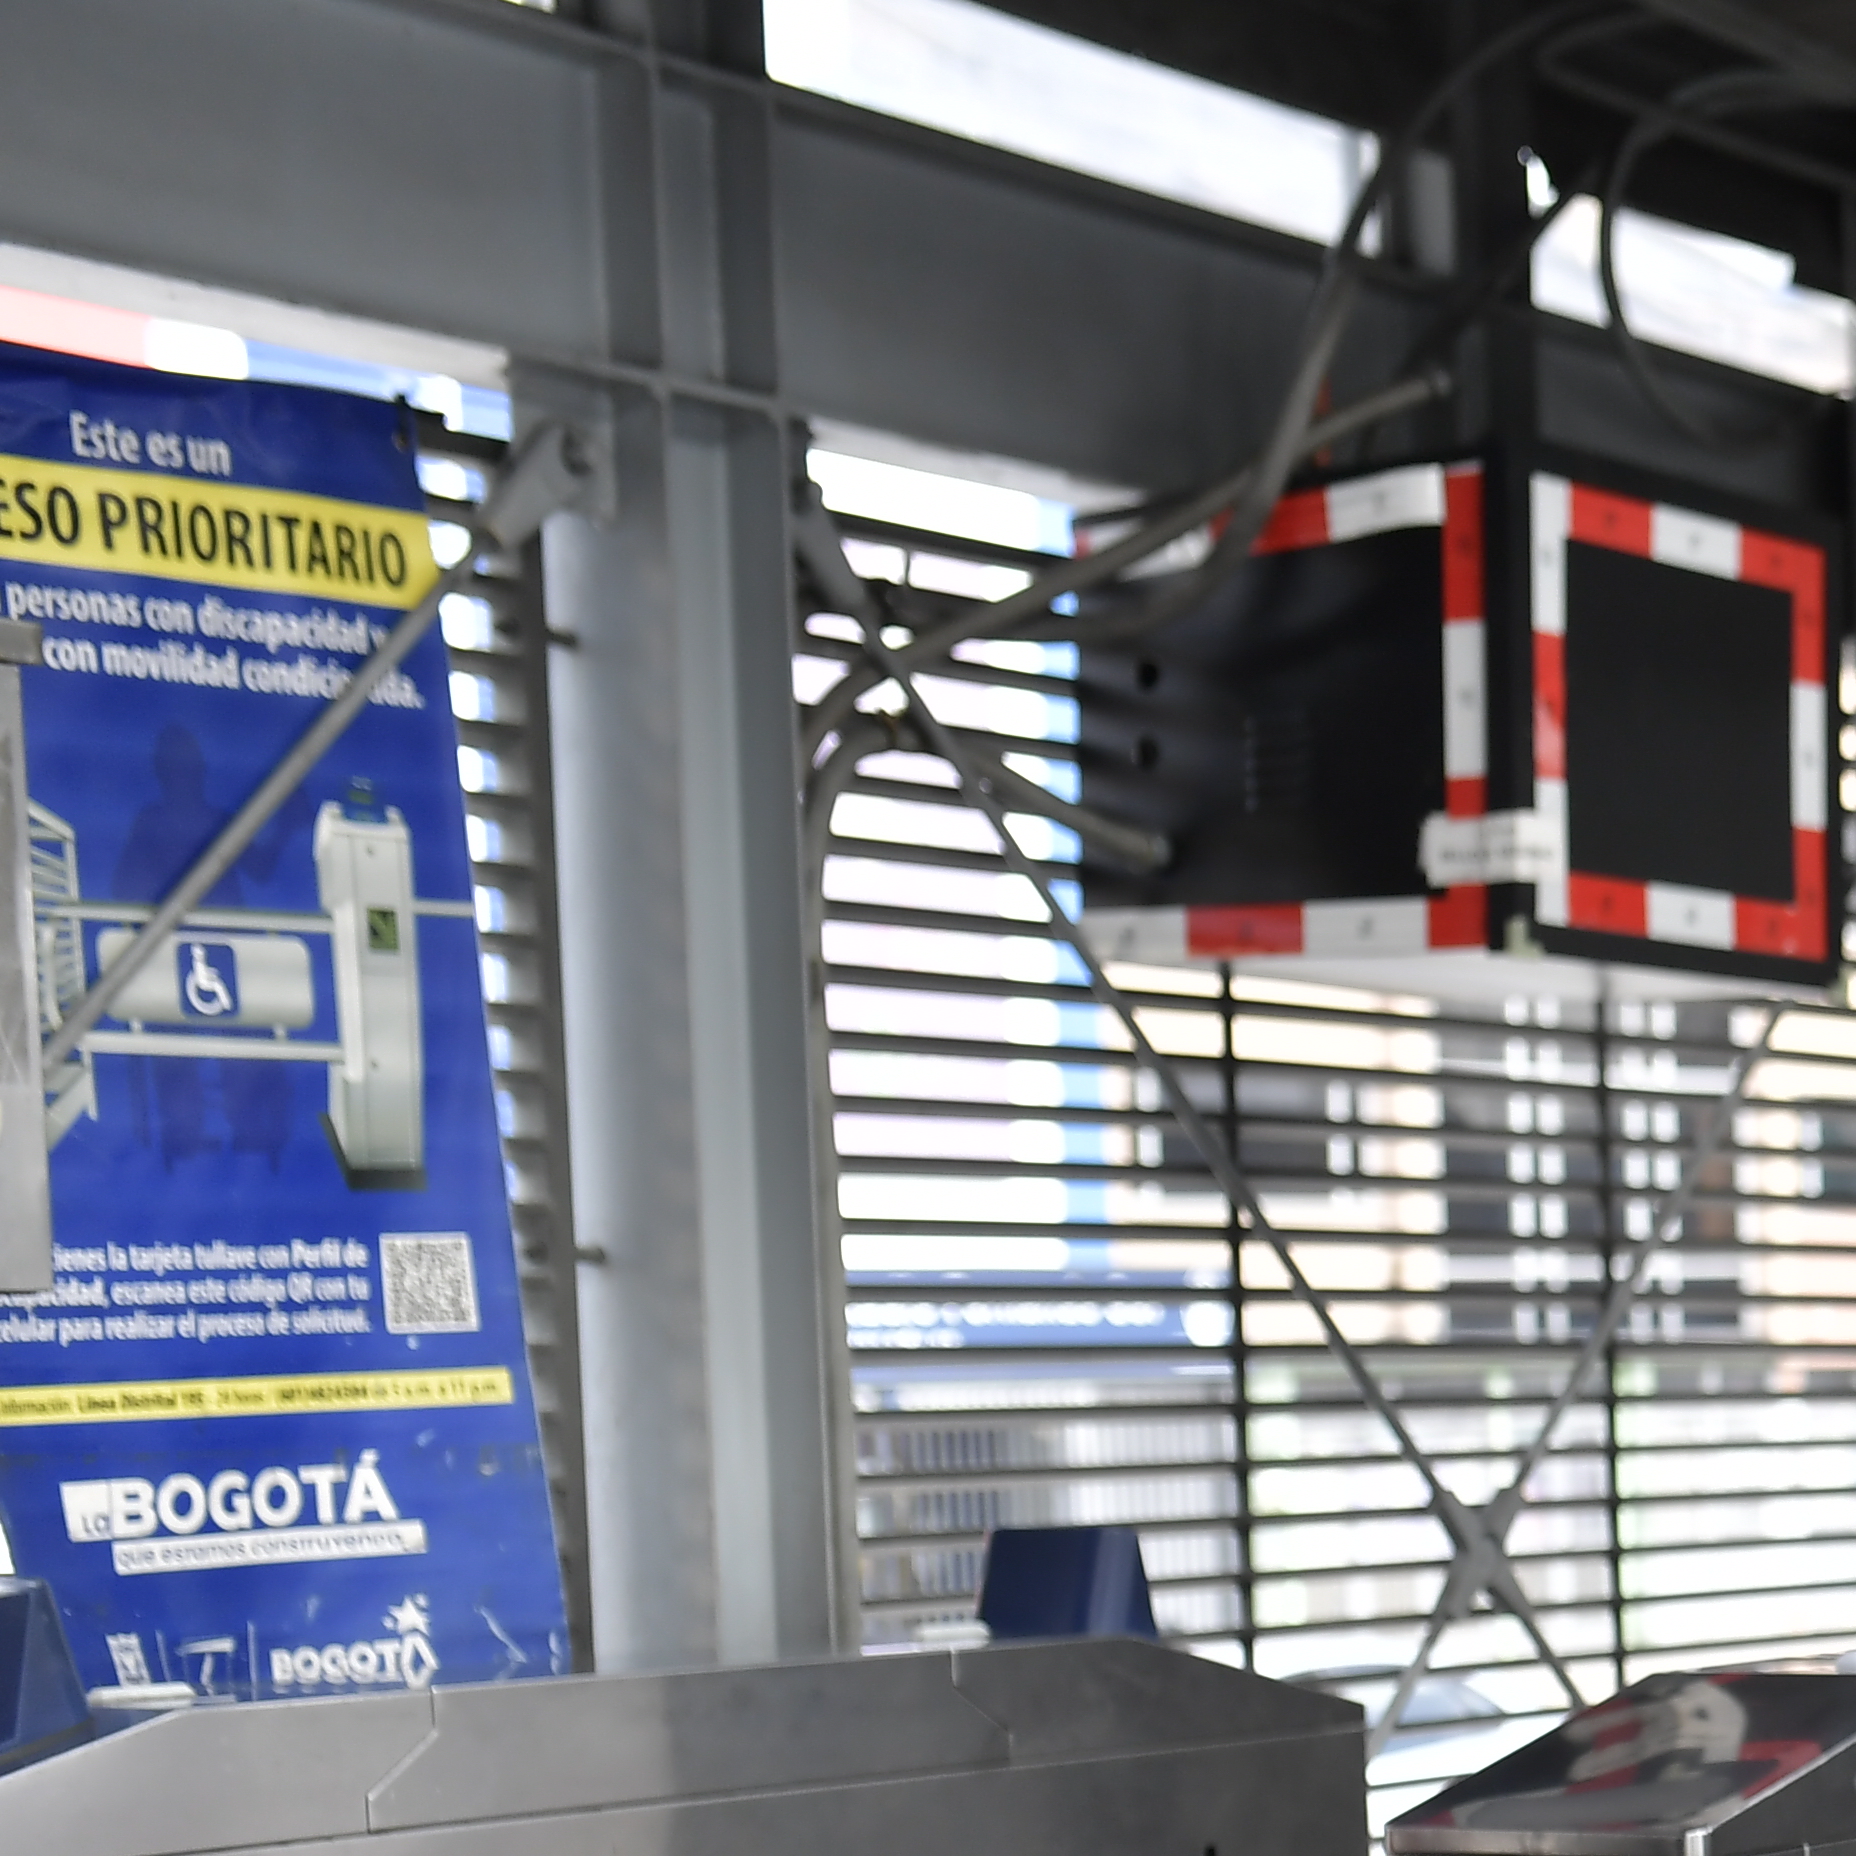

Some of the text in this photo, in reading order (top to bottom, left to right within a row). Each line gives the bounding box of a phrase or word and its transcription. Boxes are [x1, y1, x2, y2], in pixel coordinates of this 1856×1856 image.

[69, 409, 232, 477] Este es un
[96, 492, 409, 588] PRIORITARIO
[5, 580, 142, 629] personas
[143, 597, 196, 635] con
[197, 592, 371, 656] discapacidad
[42, 636, 98, 674] con
[101, 640, 241, 691] movilidad
[107, 1240, 129, 1272] la
[129, 1240, 194, 1278] tarjeta
[257, 1244, 290, 1270] con
[314, 1276, 347, 1302] con
[58, 1315, 104, 1348] para
[176, 1307, 197, 1338] el
[197, 1310, 266, 1344] proceso
[265, 1307, 291, 1337] de
[109, 1449, 398, 1540] BOGOTÁ
